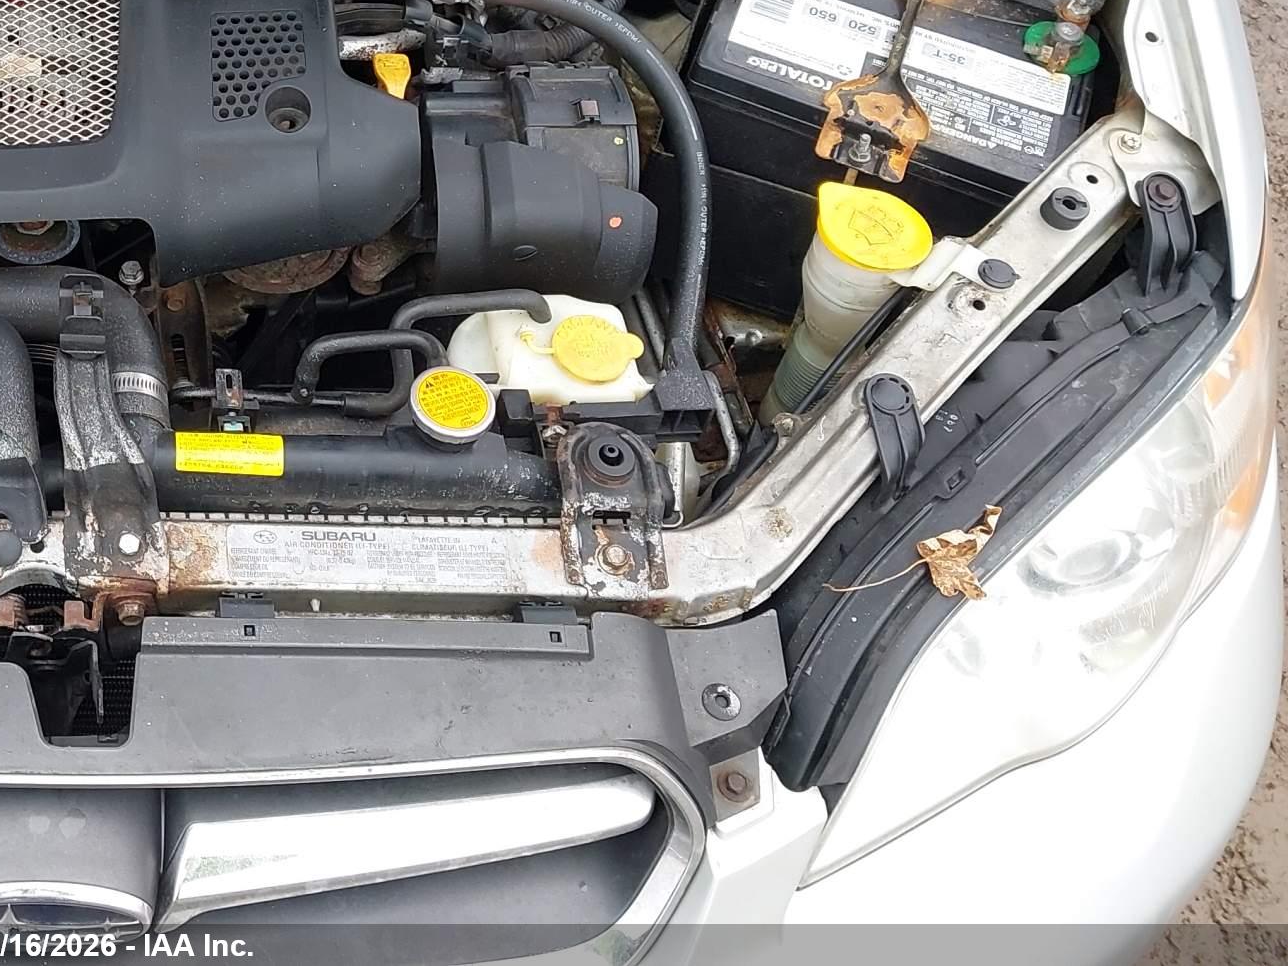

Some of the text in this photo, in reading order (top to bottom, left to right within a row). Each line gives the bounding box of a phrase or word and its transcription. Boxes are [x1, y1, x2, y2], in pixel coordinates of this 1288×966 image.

[808, 5, 837, 23] 650
[847, 19, 877, 35] 520
[932, 47, 966, 65] 35-T
[744, 53, 834, 92] TOTALPRO
[928, 121, 988, 146] DANGER/P
[299, 541, 353, 550] CONDITIONER
[301, 531, 376, 542] SUBARU
